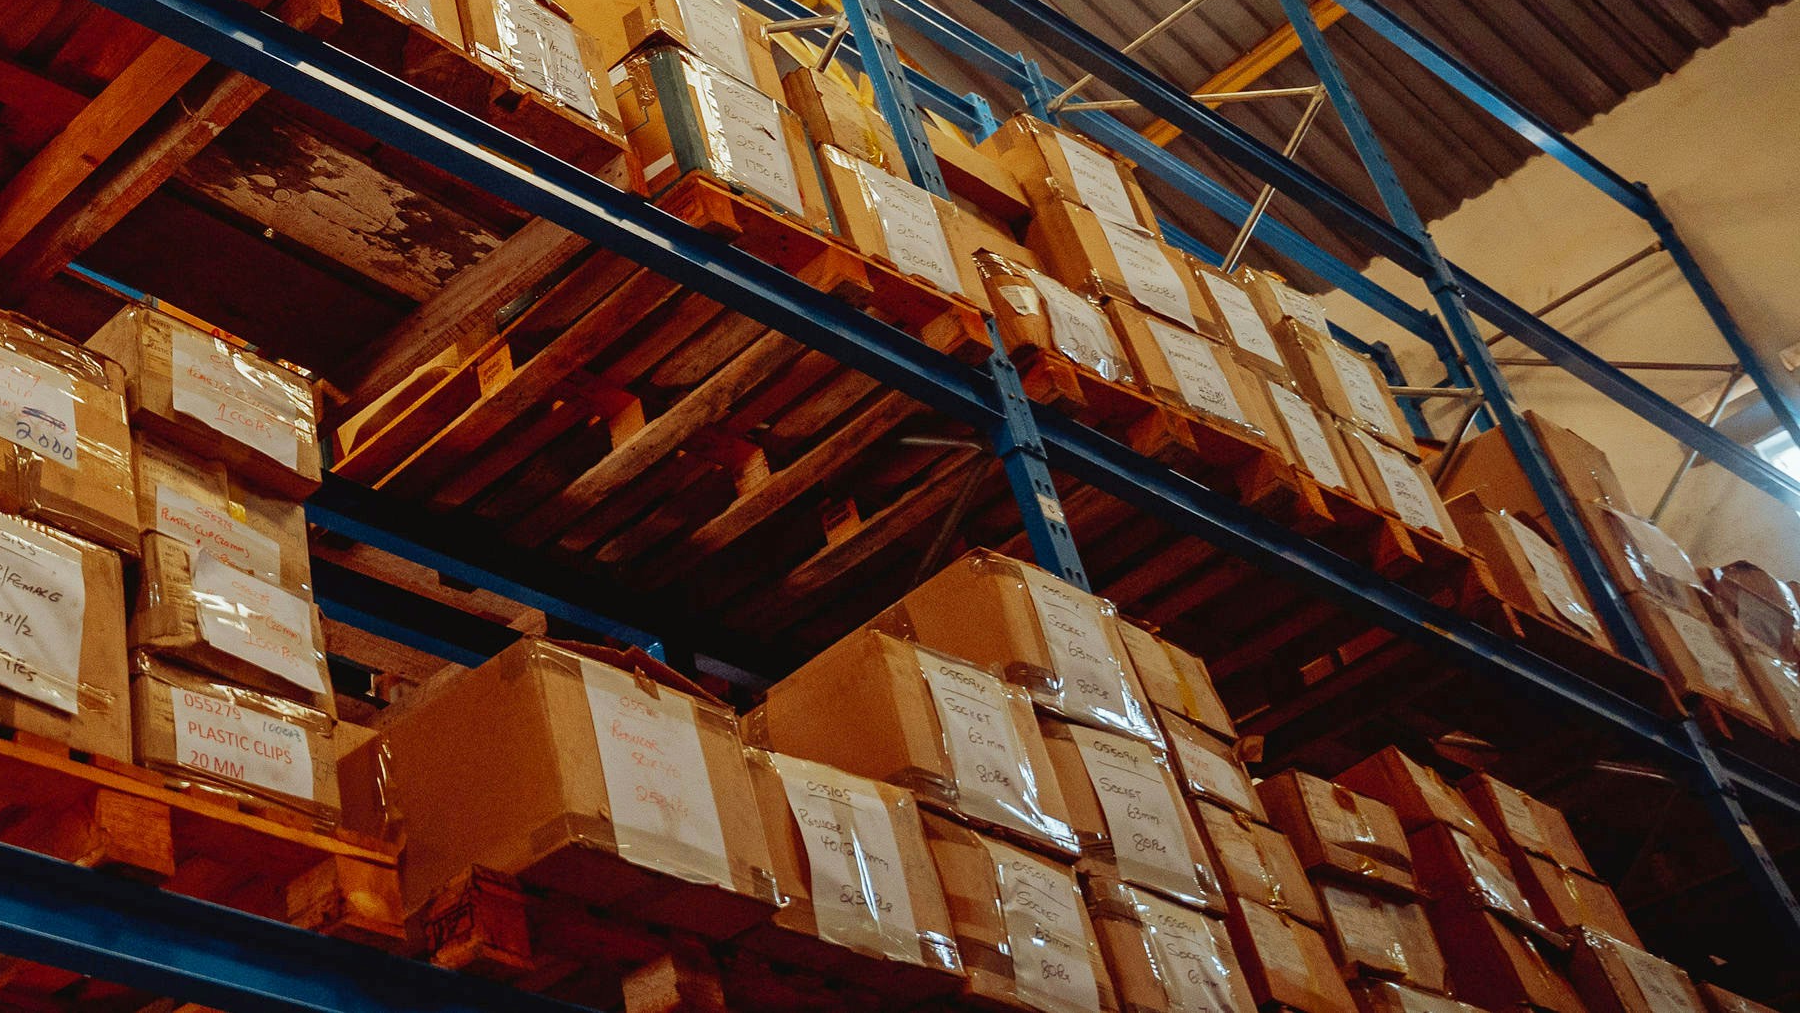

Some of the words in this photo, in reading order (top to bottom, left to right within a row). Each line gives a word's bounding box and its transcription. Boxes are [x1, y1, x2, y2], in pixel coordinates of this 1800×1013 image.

[16, 421, 73, 460] 2000
[184, 693, 242, 720] 055279
[188, 721, 249, 751] PLASTIC
[253, 740, 293, 765] CLIPS
[190, 750, 210, 769] 20
[214, 756, 245, 780] MM
